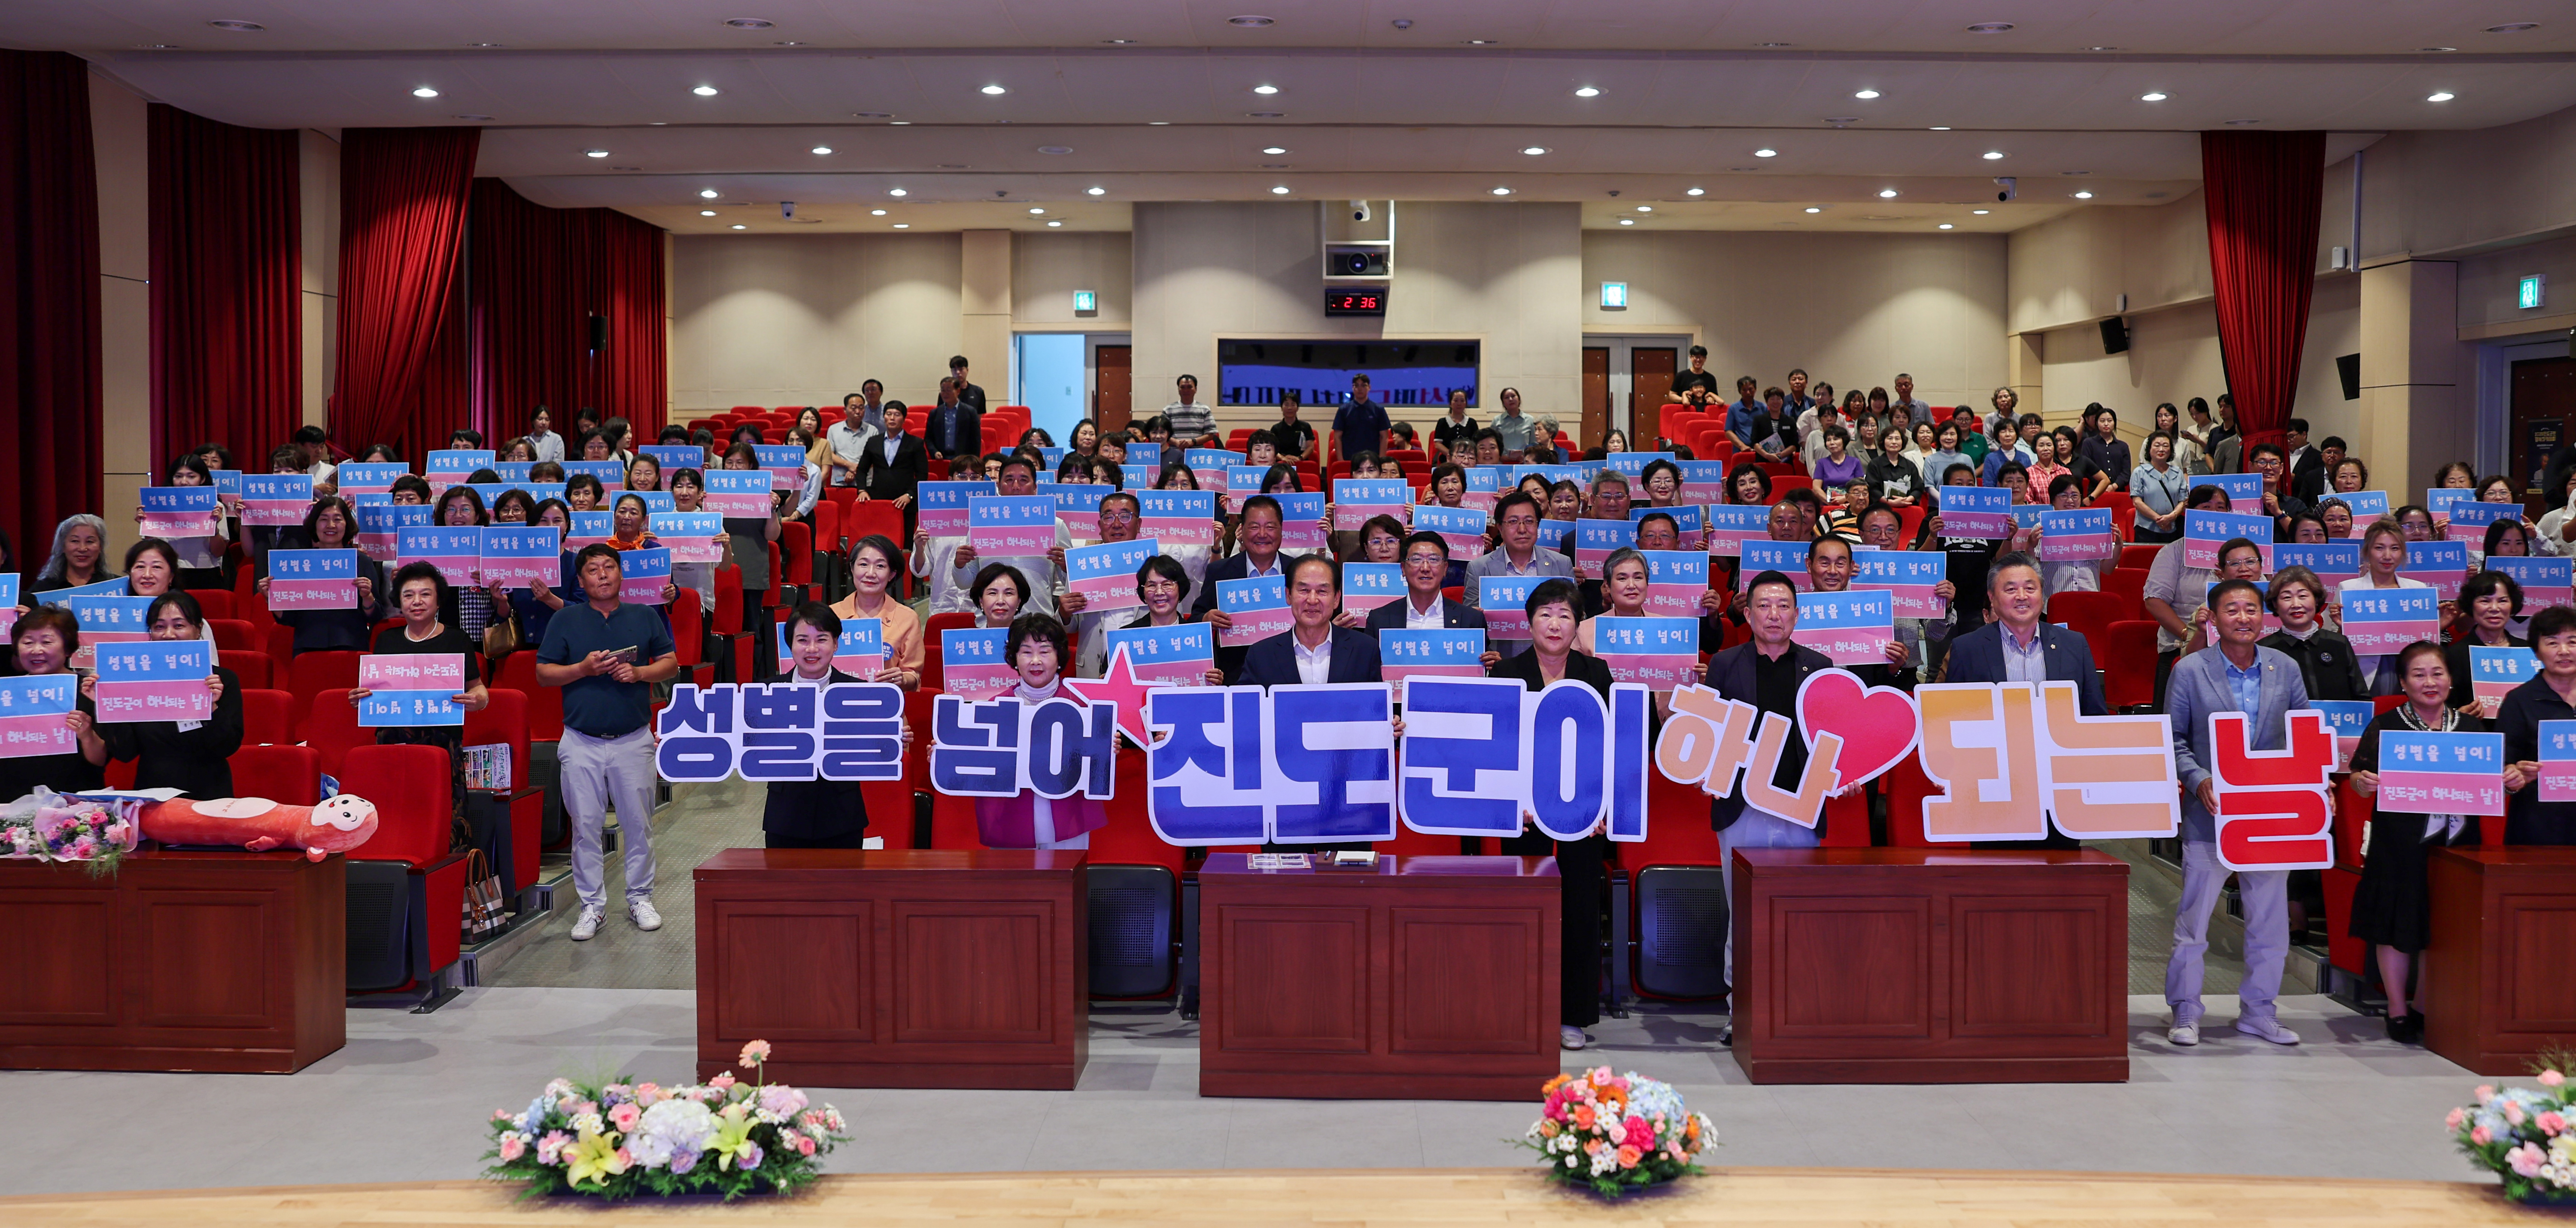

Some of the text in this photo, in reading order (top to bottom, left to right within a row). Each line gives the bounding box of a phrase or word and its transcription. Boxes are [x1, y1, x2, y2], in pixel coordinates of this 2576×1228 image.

[678, 453, 697, 461] 넘어!
[782, 453, 800, 461] 넘어!
[1136, 451, 1154, 459] 넘어!
[1192, 455, 1212, 464] 성별을
[434, 457, 488, 467] 성별을 넘어!
[1615, 460, 1640, 470] 성별을
[346, 471, 372, 480] 성별을
[598, 468, 617, 477] 넘어!
[1697, 468, 1716, 476] 넘어!
[712, 478, 765, 488] 성별을 넘어!
[1473, 476, 1492, 485] 넘어!
[249, 482, 305, 493] 성별을 넘어!
[1343, 487, 1400, 498] 성별을 넘어!
[2234, 482, 2256, 492] 넘어!
[149, 494, 209, 506] 성별을 넘어!
[928, 491, 956, 502] 성별을
[1949, 495, 2005, 506] 성별을 넘어!
[649, 499, 668, 508] 넘어!
[706, 502, 769, 512] 진도군이 하나되는 날!
[1145, 499, 1206, 510] 성별을 넘어!
[1294, 501, 1317, 512] 넘어!
[2361, 498, 2382, 508] 넘어!
[246, 509, 295, 518] 진도군이 하나되는
[980, 505, 1047, 518] 성별을 넘어!
[2458, 509, 2485, 520] 성별을
[145, 519, 216, 530] 진도군이 하나되는 날!
[366, 514, 426, 526] 성별을 넘어!
[585, 519, 606, 529] 넘어!
[1337, 515, 1362, 523] 진도군이
[1422, 514, 1479, 527] 성별을 넘어!
[1718, 513, 1744, 524] 성별을
[2049, 516, 2105, 529] 성별을 넘어!
[658, 520, 715, 530] 성별을 넘어!
[923, 520, 949, 530] 진도군이
[1069, 522, 1096, 531] 하나되는
[1942, 521, 1994, 531] 진도군이 하나되는
[2196, 520, 2264, 536] 성별을 넘어!
[1169, 527, 1211, 539] 하나되는 날!
[1312, 530, 1323, 541] 날!
[1587, 529, 1618, 542] 성별을
[407, 536, 475, 548] 성별을 넘어!
[491, 537, 550, 549] 성별을 넘어!
[973, 536, 1053, 549] 진도군이 하나되는 날!
[1713, 540, 1737, 549] 진도군이
[680, 546, 704, 555] 하나되는
[1471, 545, 1483, 555] 날!
[2044, 546, 2069, 554] 진도군이
[2100, 543, 2110, 552] 날!
[1078, 555, 1111, 570] 성별을
[1751, 550, 1782, 563] 성별을
[2283, 553, 2351, 565] 성별을 넘어!
[2434, 551, 2460, 562] 넘어!
[279, 558, 348, 572] 성별을 넘어!
[640, 557, 664, 569] 넘어!
[1672, 562, 1699, 574] 넘어!
[1909, 563, 1937, 575] 넘어!
[484, 568, 557, 579] 진도군이 하나되는 날!
[2539, 567, 2564, 578] 넘어!
[1355, 574, 1388, 587] 성별을
[273, 589, 354, 602] 진도군이 하나되는 날!
[628, 588, 655, 597] 하나되는
[1227, 588, 1261, 603] 성별을
[1491, 587, 1525, 601] 성별을
[1655, 595, 1686, 607] 하나되는
[1929, 597, 1942, 610] 날!
[2353, 598, 2429, 613] 성별을 넘어!
[2523, 597, 2552, 608] 하나되는
[82, 608, 119, 622] 성별을
[1851, 602, 1882, 616] 넘어!
[1259, 621, 1291, 631] 하나되는
[841, 630, 872, 645] 넘어!
[1607, 629, 1688, 644] 성별을 넘어!
[2347, 633, 2417, 646] 진도군이 하나되는
[955, 640, 993, 655] 성별을
[1171, 635, 1202, 651] 넘어!
[1392, 641, 1474, 655] 성별을 넘어!
[1835, 641, 1870, 653] 하나되는
[109, 653, 200, 671] 성별을 넘어!
[2481, 659, 2517, 673] 성별을
[1639, 667, 1694, 682] 하나되는 날!
[949, 679, 985, 691] 진도군이
[27, 687, 64, 703] 넘어!
[102, 694, 208, 711] 진도군이 하나되는 날!
[2331, 713, 2362, 726] 넘어!
[7, 728, 72, 744] 하나되는 날!
[2394, 745, 2491, 761] 성별을 넘어!
[659, 682, 2333, 864] 성별을 넘어 진도군이 하나 되는 날
[2384, 786, 2500, 805] 진도군이 하나되는 날!
